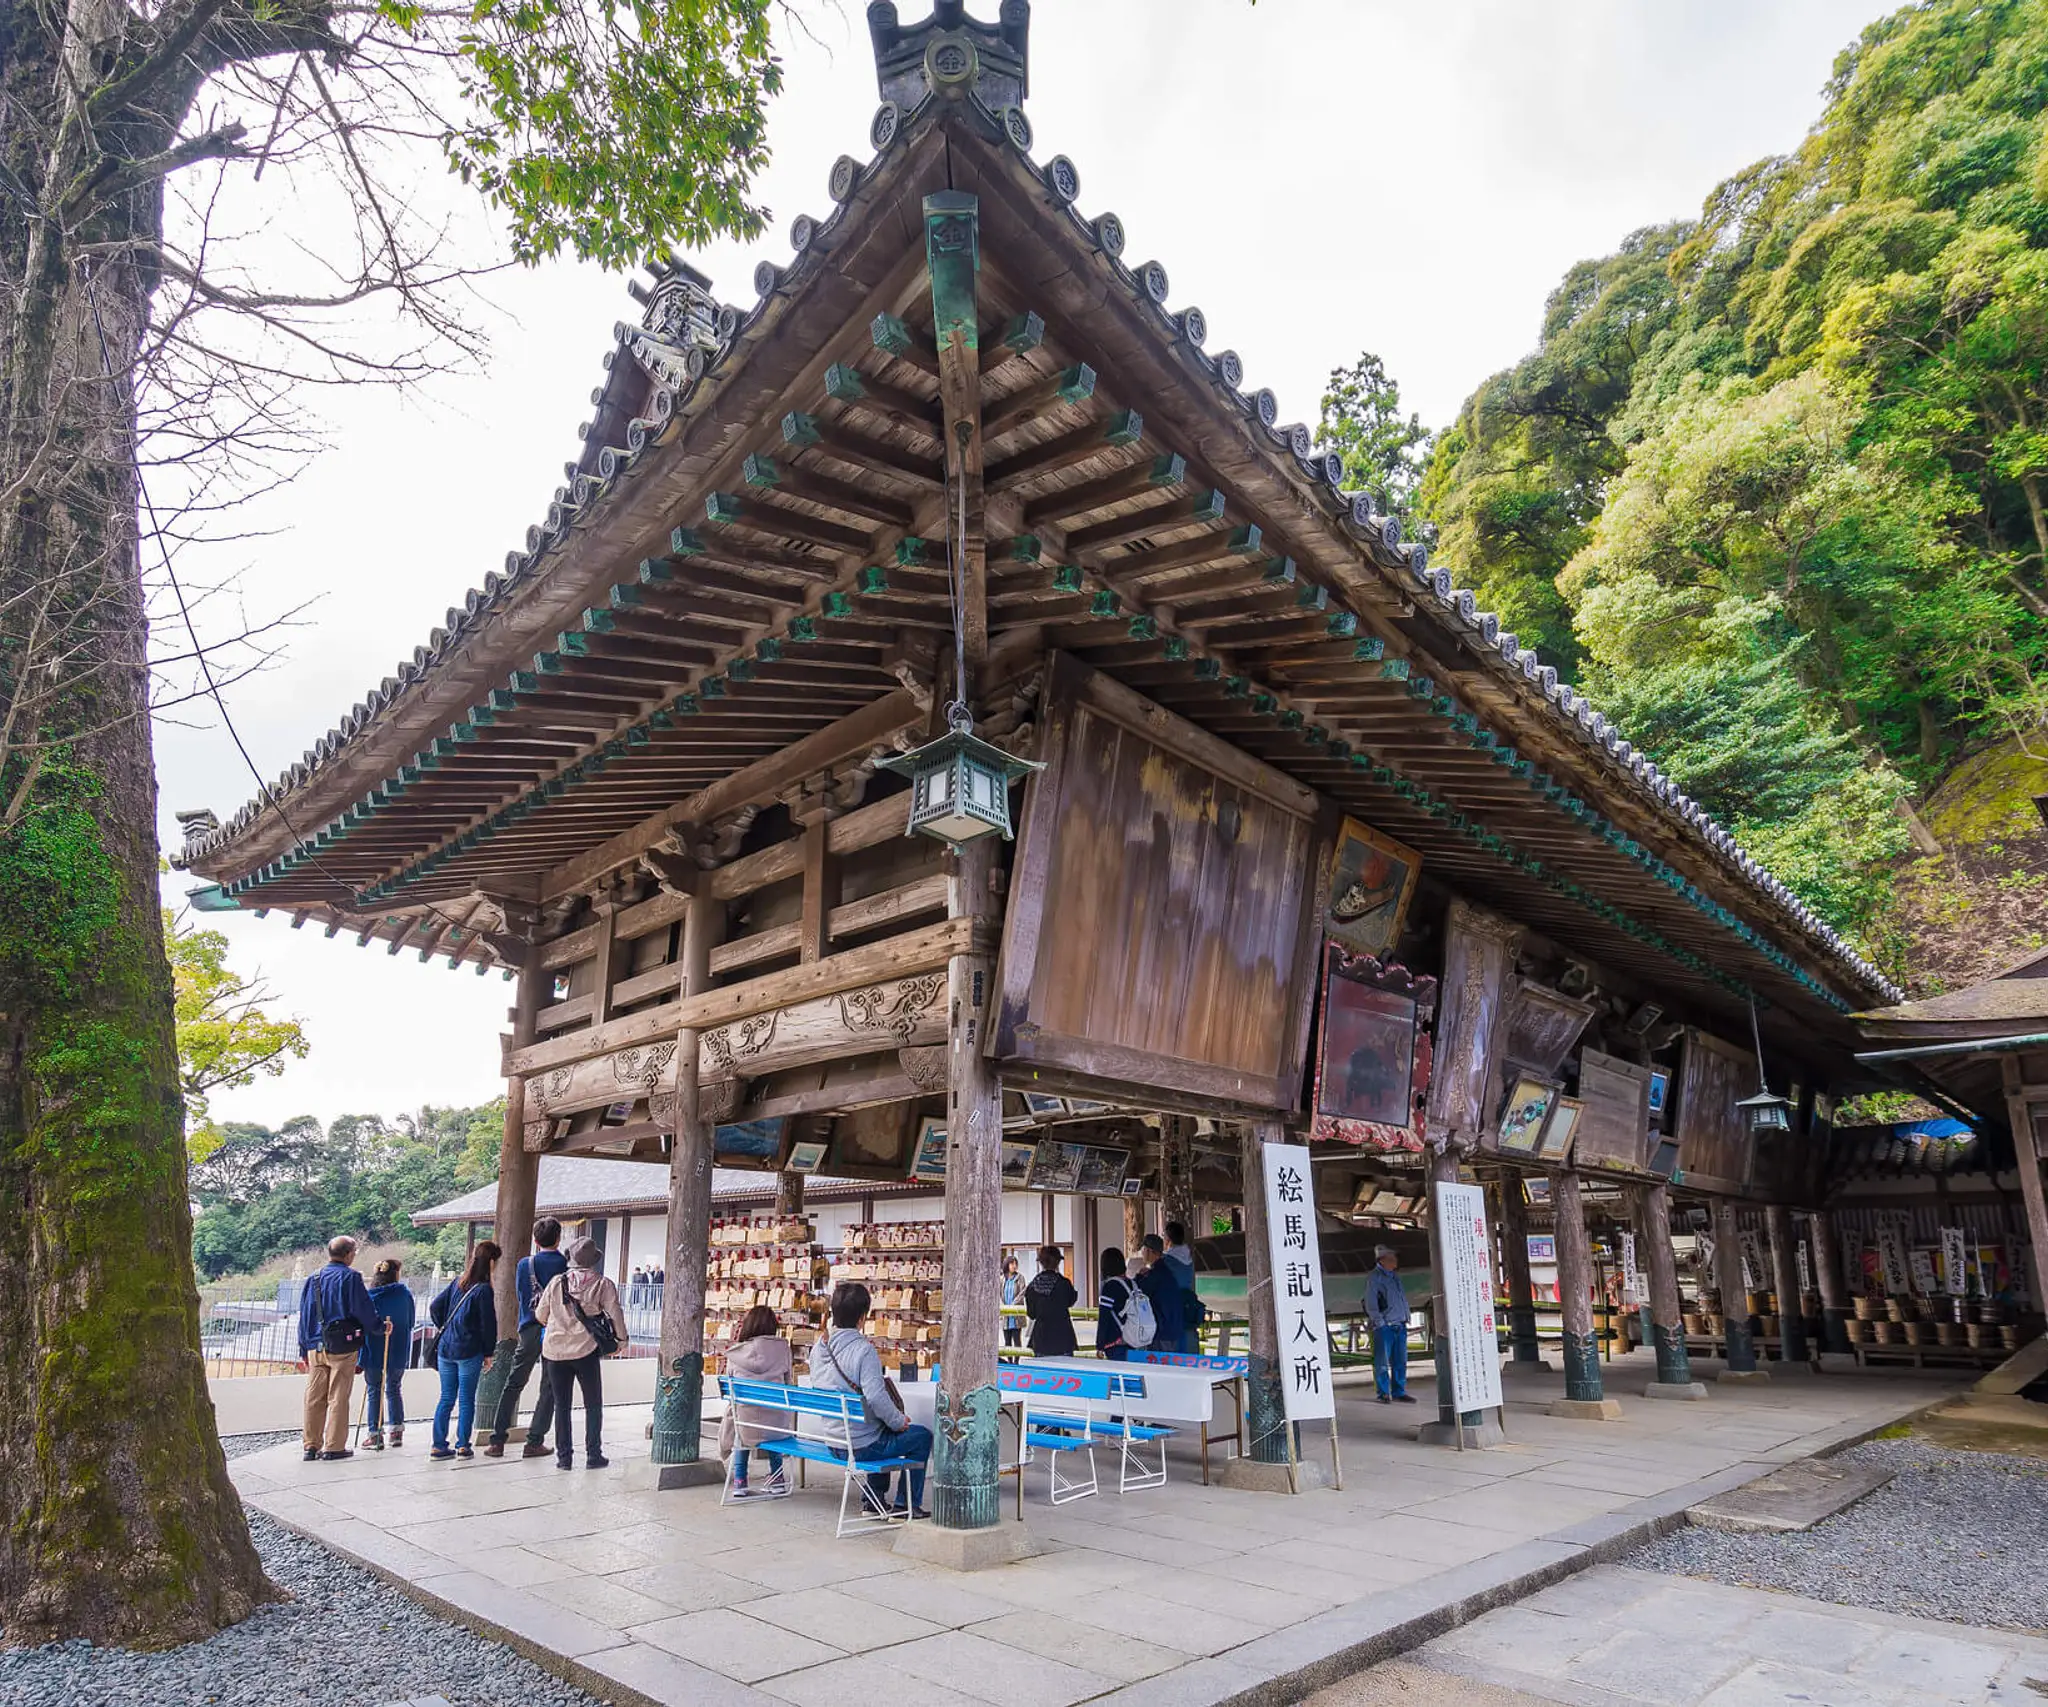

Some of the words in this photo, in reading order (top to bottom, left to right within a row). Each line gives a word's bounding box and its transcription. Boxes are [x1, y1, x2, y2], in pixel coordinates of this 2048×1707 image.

[1277, 1166, 1322, 1395] 絵馬記入所
